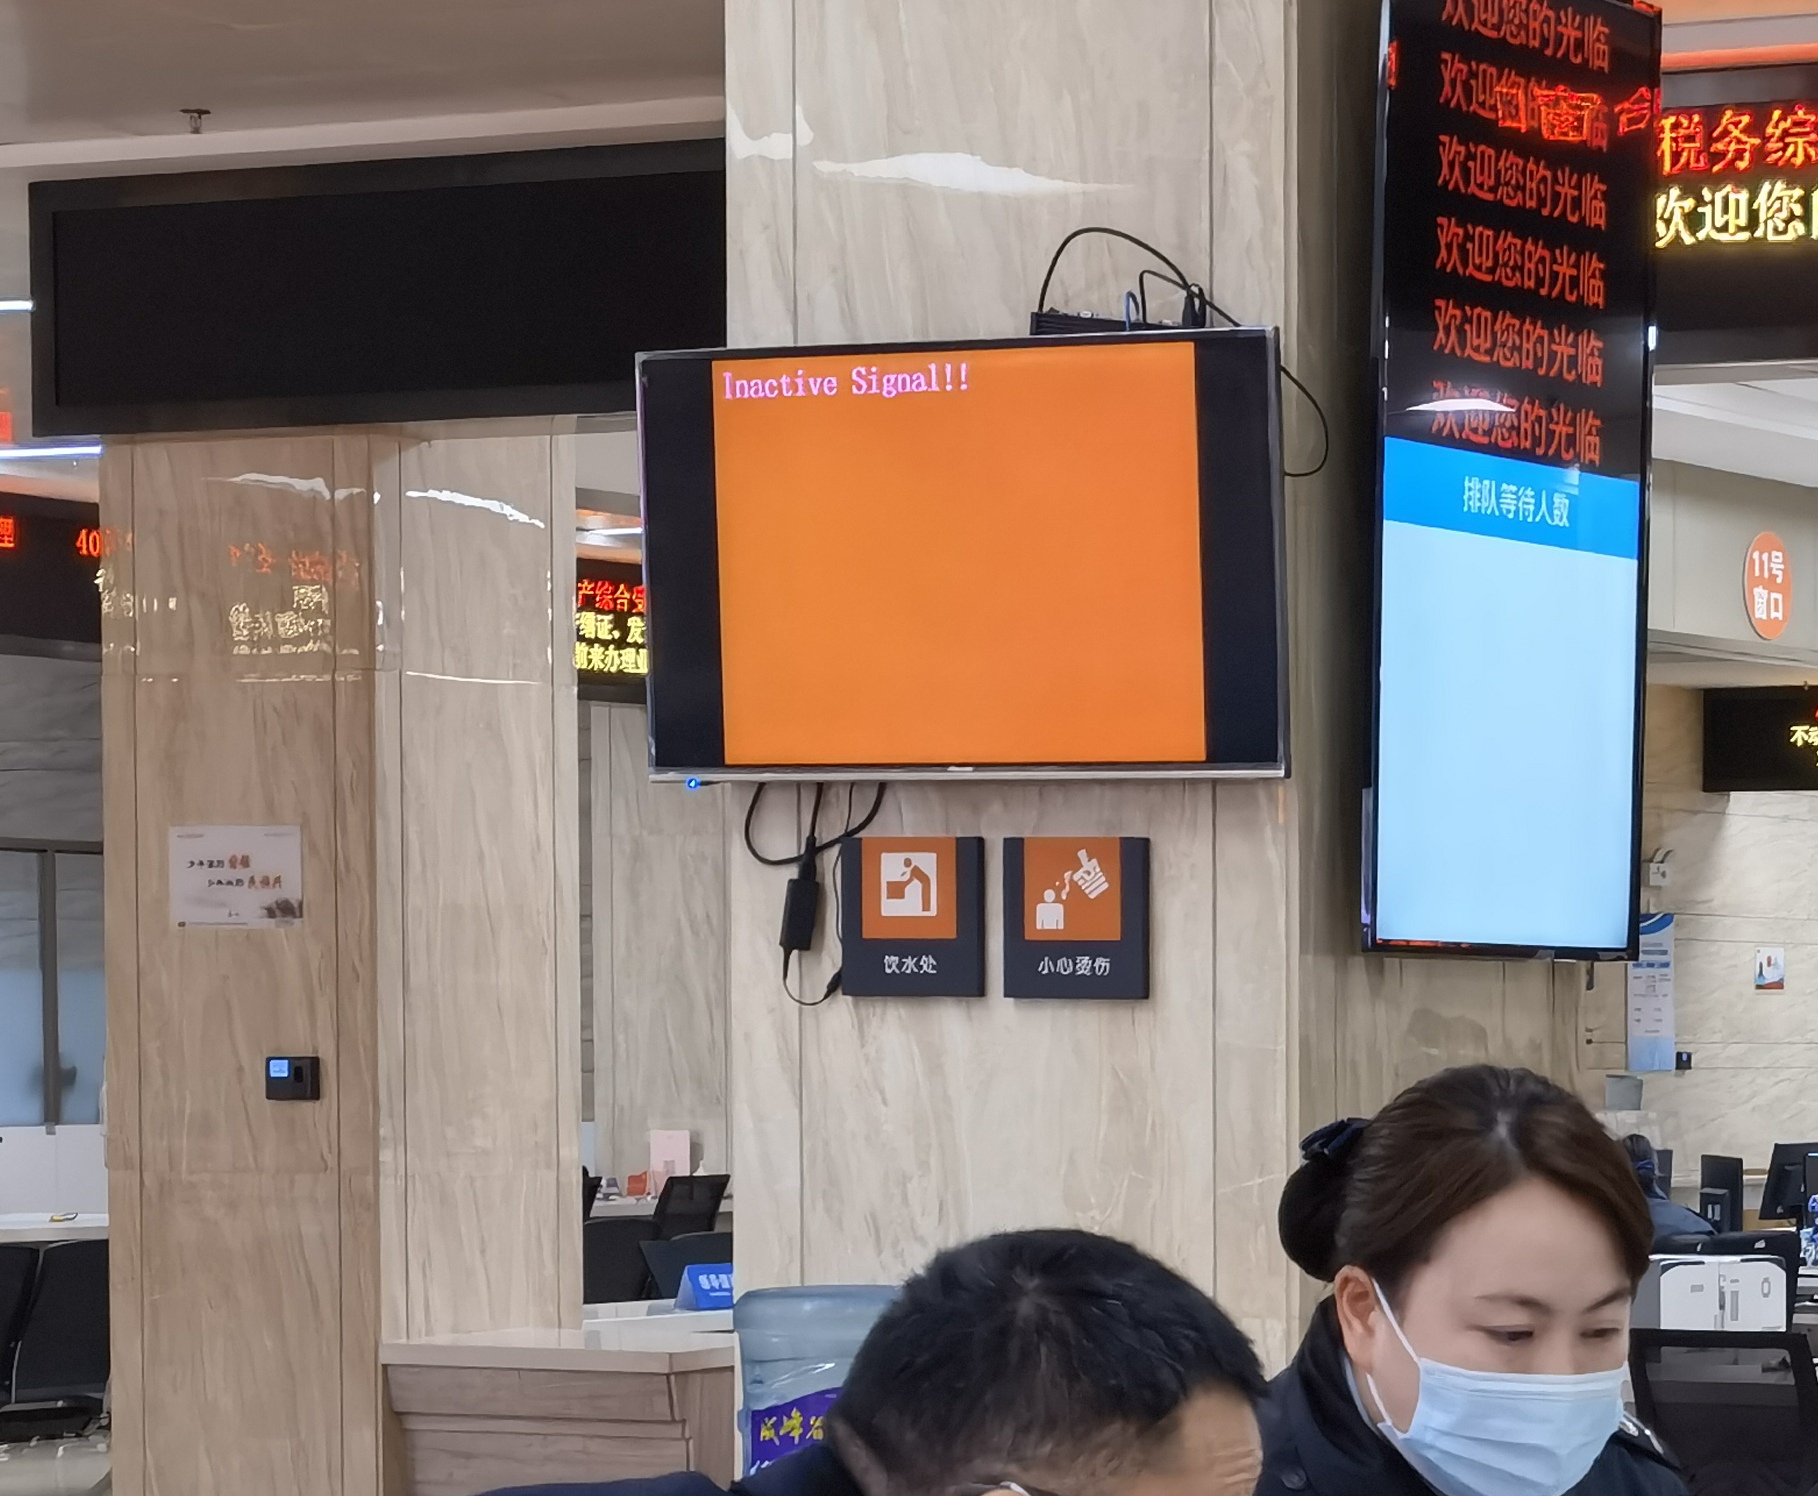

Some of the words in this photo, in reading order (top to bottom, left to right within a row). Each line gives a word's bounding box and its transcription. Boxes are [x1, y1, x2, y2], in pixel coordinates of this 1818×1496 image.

[1437, 134, 1608, 231] 欢迎您的光临
[1435, 216, 1607, 311] 欢迎您的光临
[1432, 298, 1604, 388] 欢迎您的光临
[723, 370, 838, 400] Inactive
[851, 362, 970, 398] Signal!!
[1430, 380, 1603, 468] 欢迎您的光临
[1462, 475, 1570, 528] 排队等待人数
[1752, 550, 1785, 584] 11号
[1752, 585, 1784, 621] 窗口
[883, 955, 937, 974] 饮水处
[1038, 956, 1111, 976] 小心烫伤
